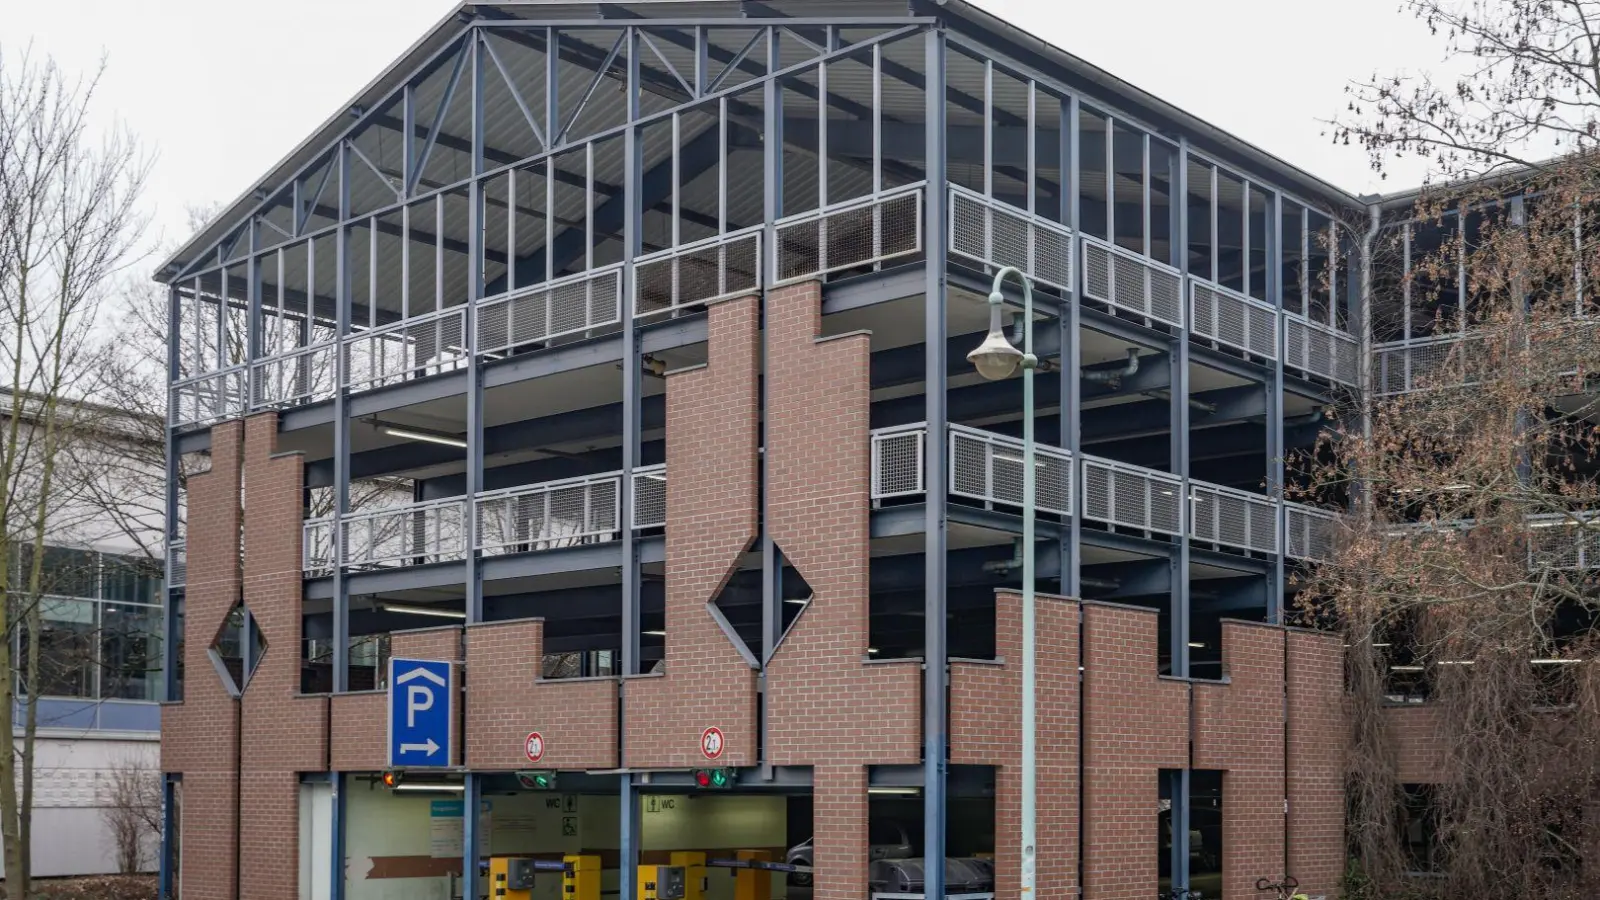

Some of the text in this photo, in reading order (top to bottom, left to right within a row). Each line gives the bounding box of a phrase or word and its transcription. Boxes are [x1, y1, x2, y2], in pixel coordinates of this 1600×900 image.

[408, 685, 434, 727] P
[546, 798, 560, 808] WC
[661, 799, 675, 809] WC
